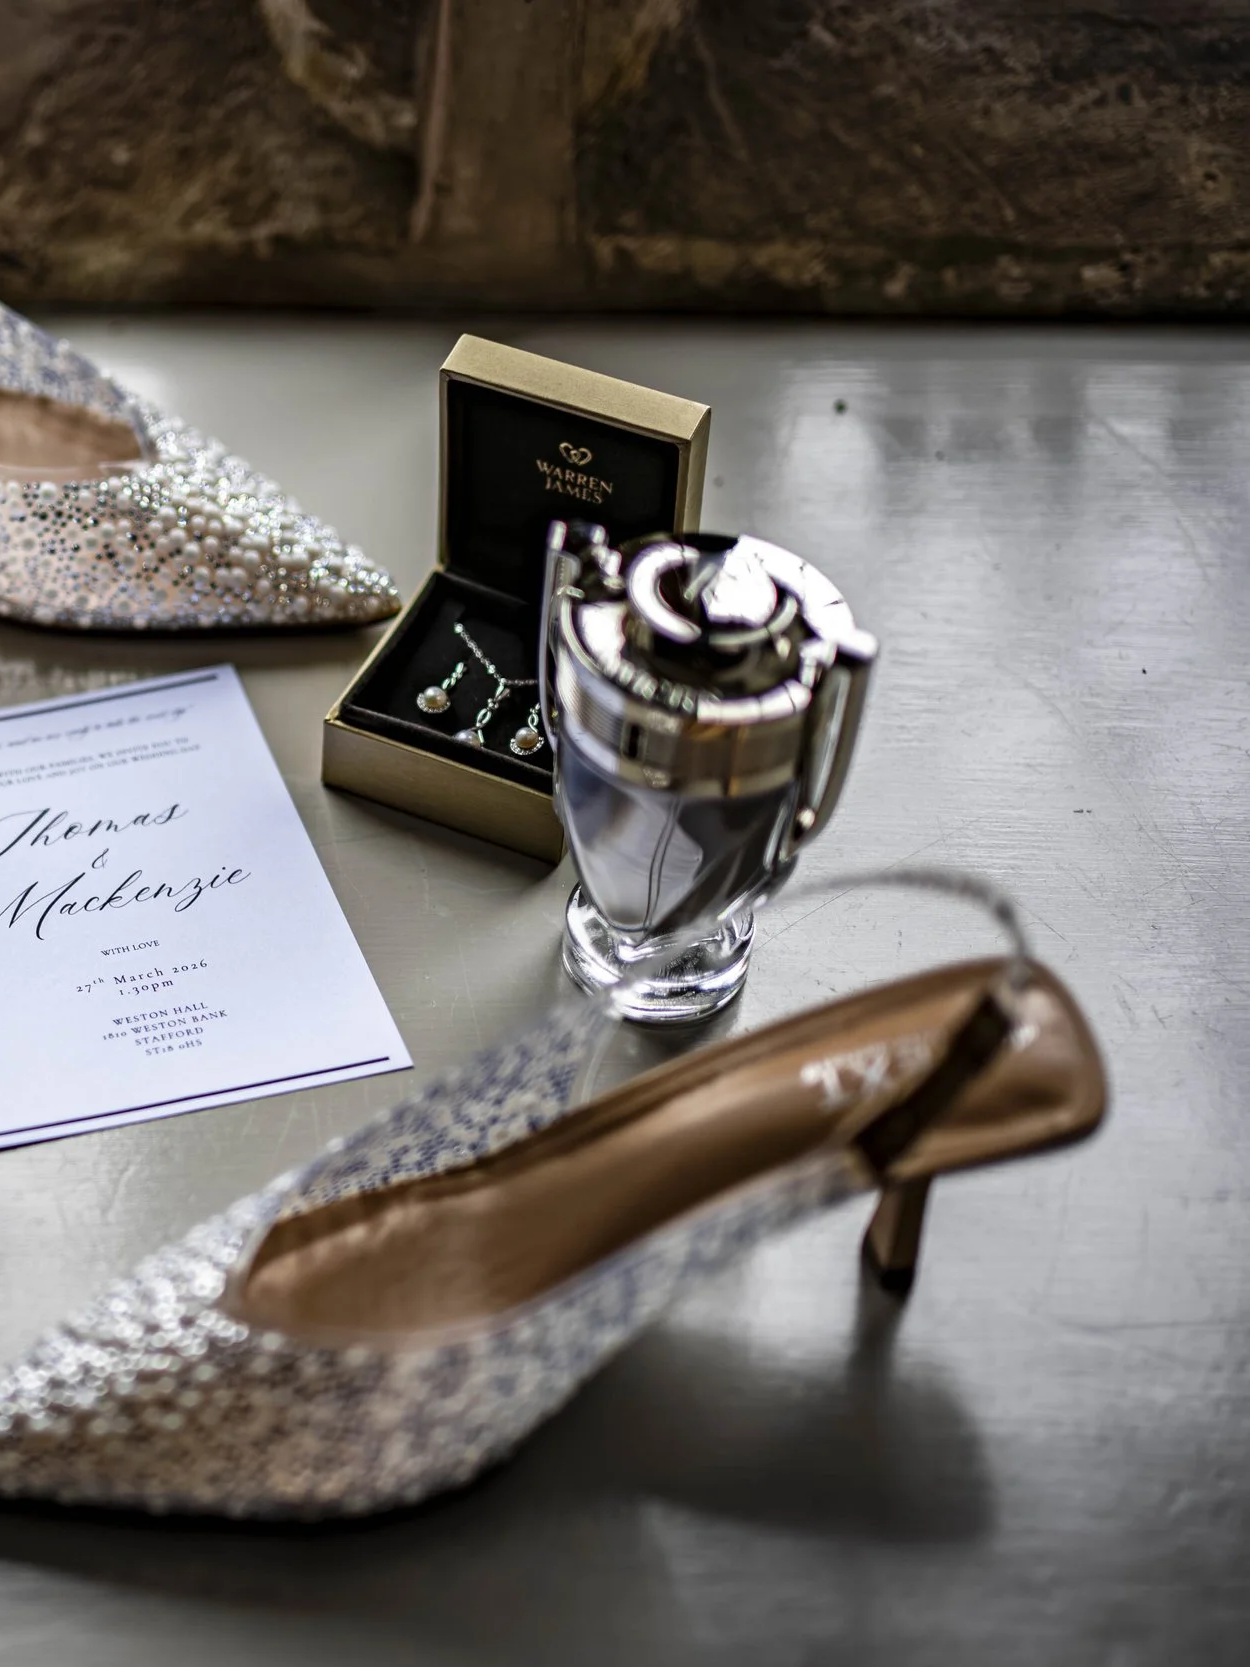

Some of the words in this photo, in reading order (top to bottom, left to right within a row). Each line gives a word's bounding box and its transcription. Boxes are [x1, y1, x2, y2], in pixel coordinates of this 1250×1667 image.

[535, 459, 613, 495] WARREN
[545, 477, 602, 504] JAMES
[91, 848, 110, 869] &
[100, 945, 130, 957] WITH
[132, 939, 160, 951] LOVE
[76, 977, 105, 993] 27th
[113, 967, 164, 985] March
[172, 958, 208, 974] 2026
[119, 980, 174, 996] 1.30pm
[112, 1009, 168, 1026] WESTON
[173, 1002, 208, 1015] HALL
[131, 1018, 187, 1034] WESTON
[191, 1009, 228, 1023] BANK
[135, 1026, 204, 1046] STAFFORD
[145, 1045, 174, 1056] ST18
